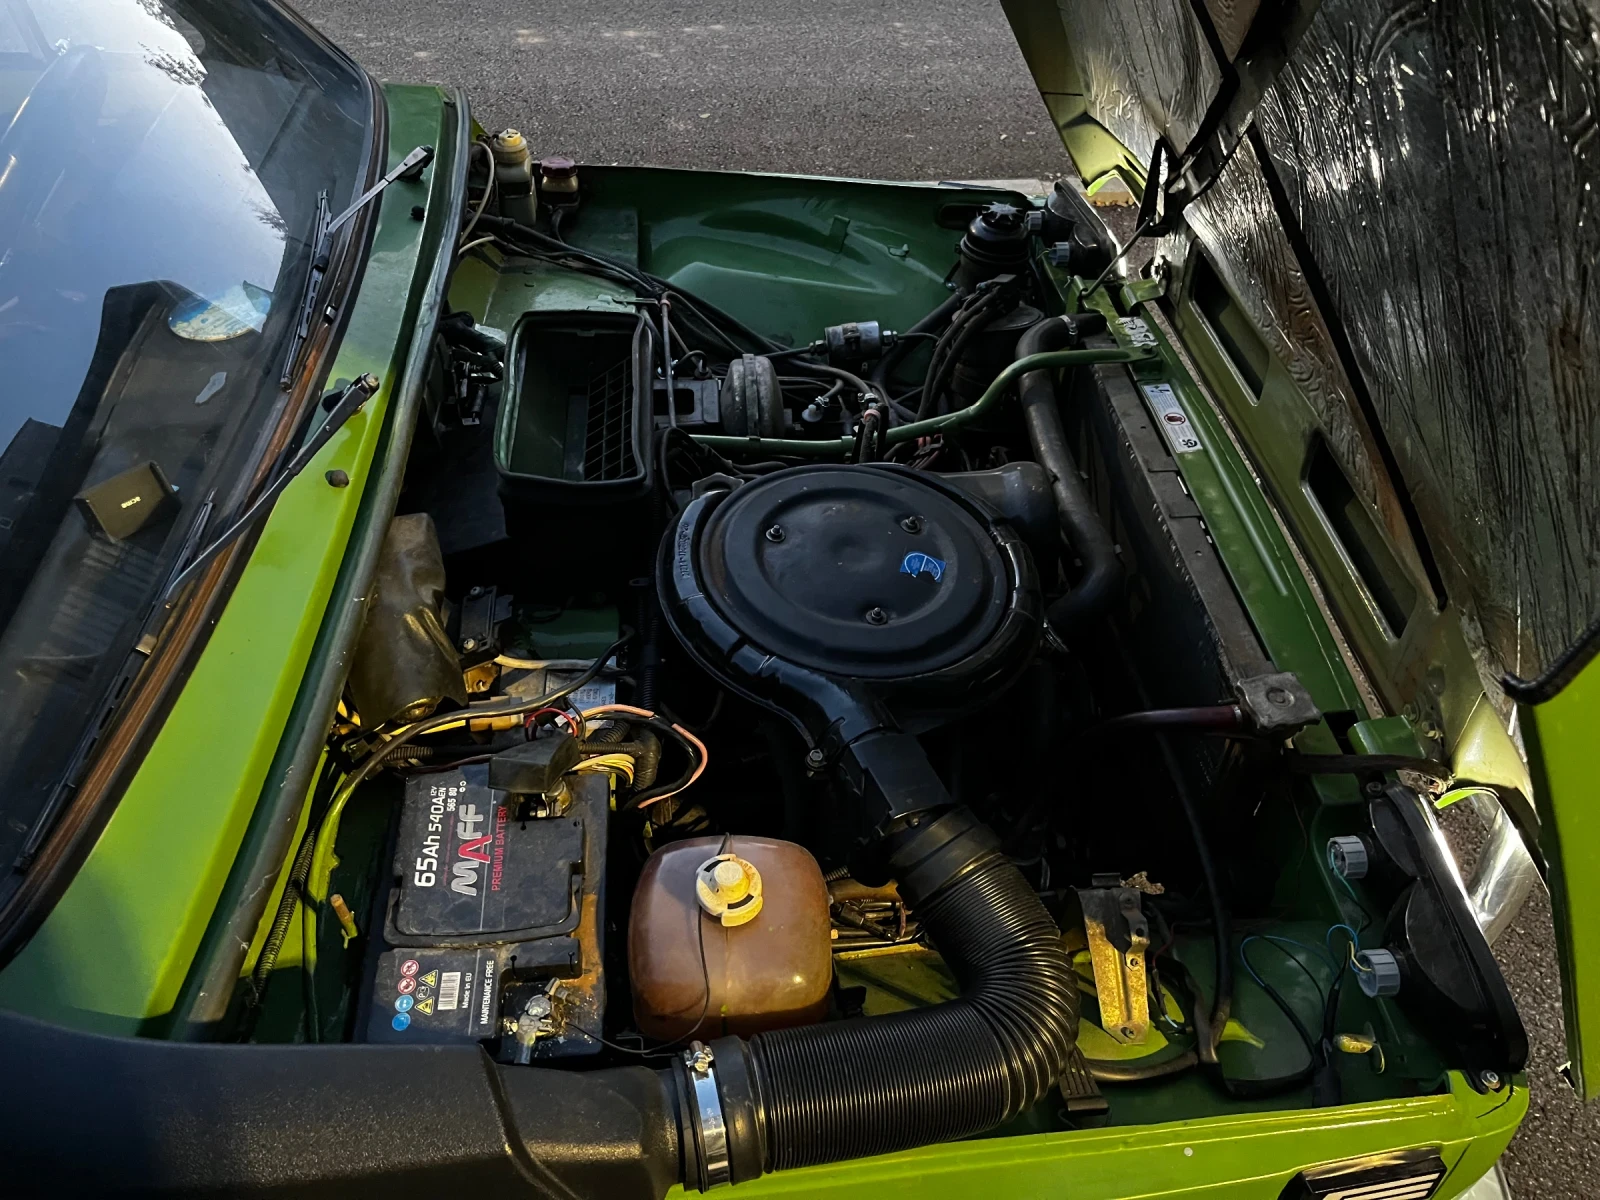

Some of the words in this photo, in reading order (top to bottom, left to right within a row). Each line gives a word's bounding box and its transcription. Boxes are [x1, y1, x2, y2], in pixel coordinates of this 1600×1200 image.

[446, 798, 457, 812] 565
[448, 787, 457, 797] 80
[495, 805, 507, 846] BATTERY
[414, 835, 441, 887] 65Ah
[451, 804, 493, 896] MAFF
[491, 847, 504, 891] PREMIUM
[465, 973, 472, 982] EU
[485, 960, 494, 977] FREE
[462, 990, 470, 1008] Made
[480, 978, 493, 1025] MAINTENANCE
